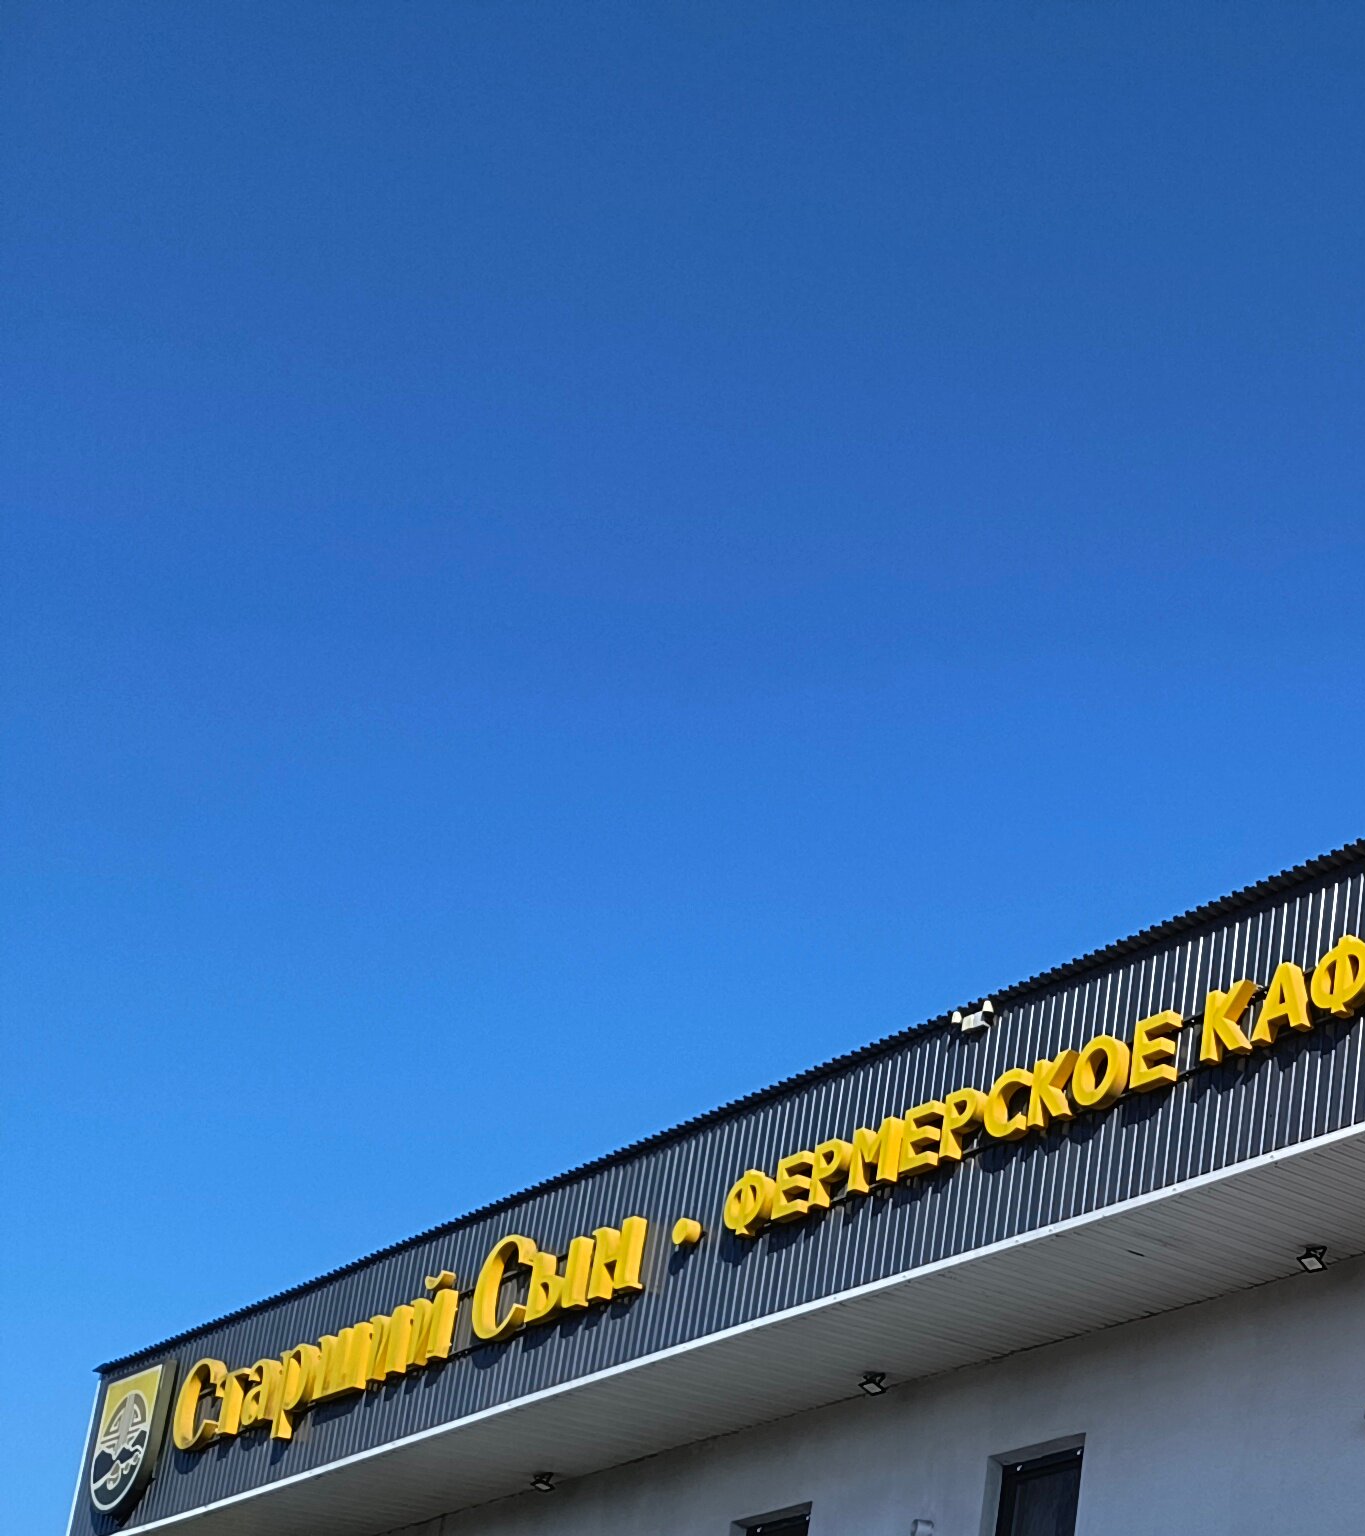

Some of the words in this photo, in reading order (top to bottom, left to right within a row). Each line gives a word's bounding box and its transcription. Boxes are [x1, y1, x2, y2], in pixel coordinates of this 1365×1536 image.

[173, 1270, 460, 1450] Старший
[472, 1214, 648, 1341] Сын
[723, 1010, 1184, 1237] ФЕРМЕРСКОЕ
